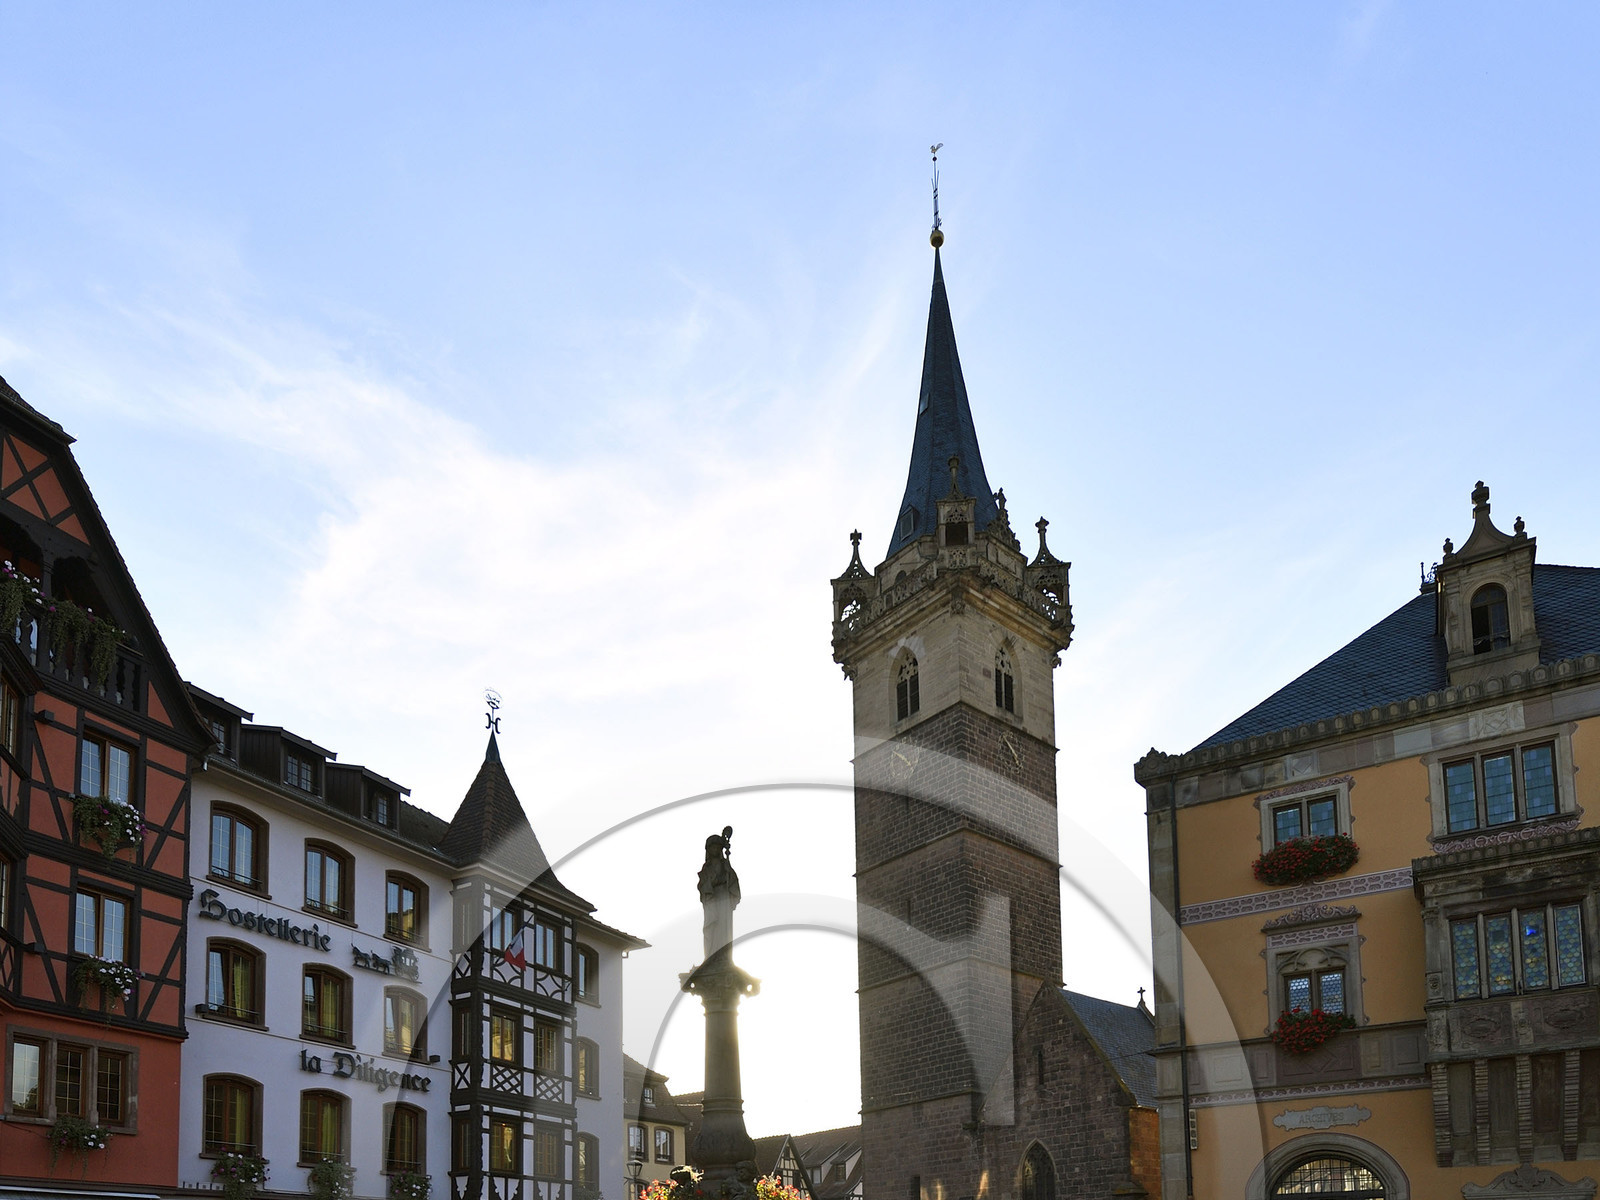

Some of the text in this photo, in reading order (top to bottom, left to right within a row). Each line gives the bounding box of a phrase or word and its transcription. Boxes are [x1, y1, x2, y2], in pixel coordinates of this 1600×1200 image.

[199, 888, 332, 952] Hostellerie
[300, 1049, 432, 1093] la Diligence
